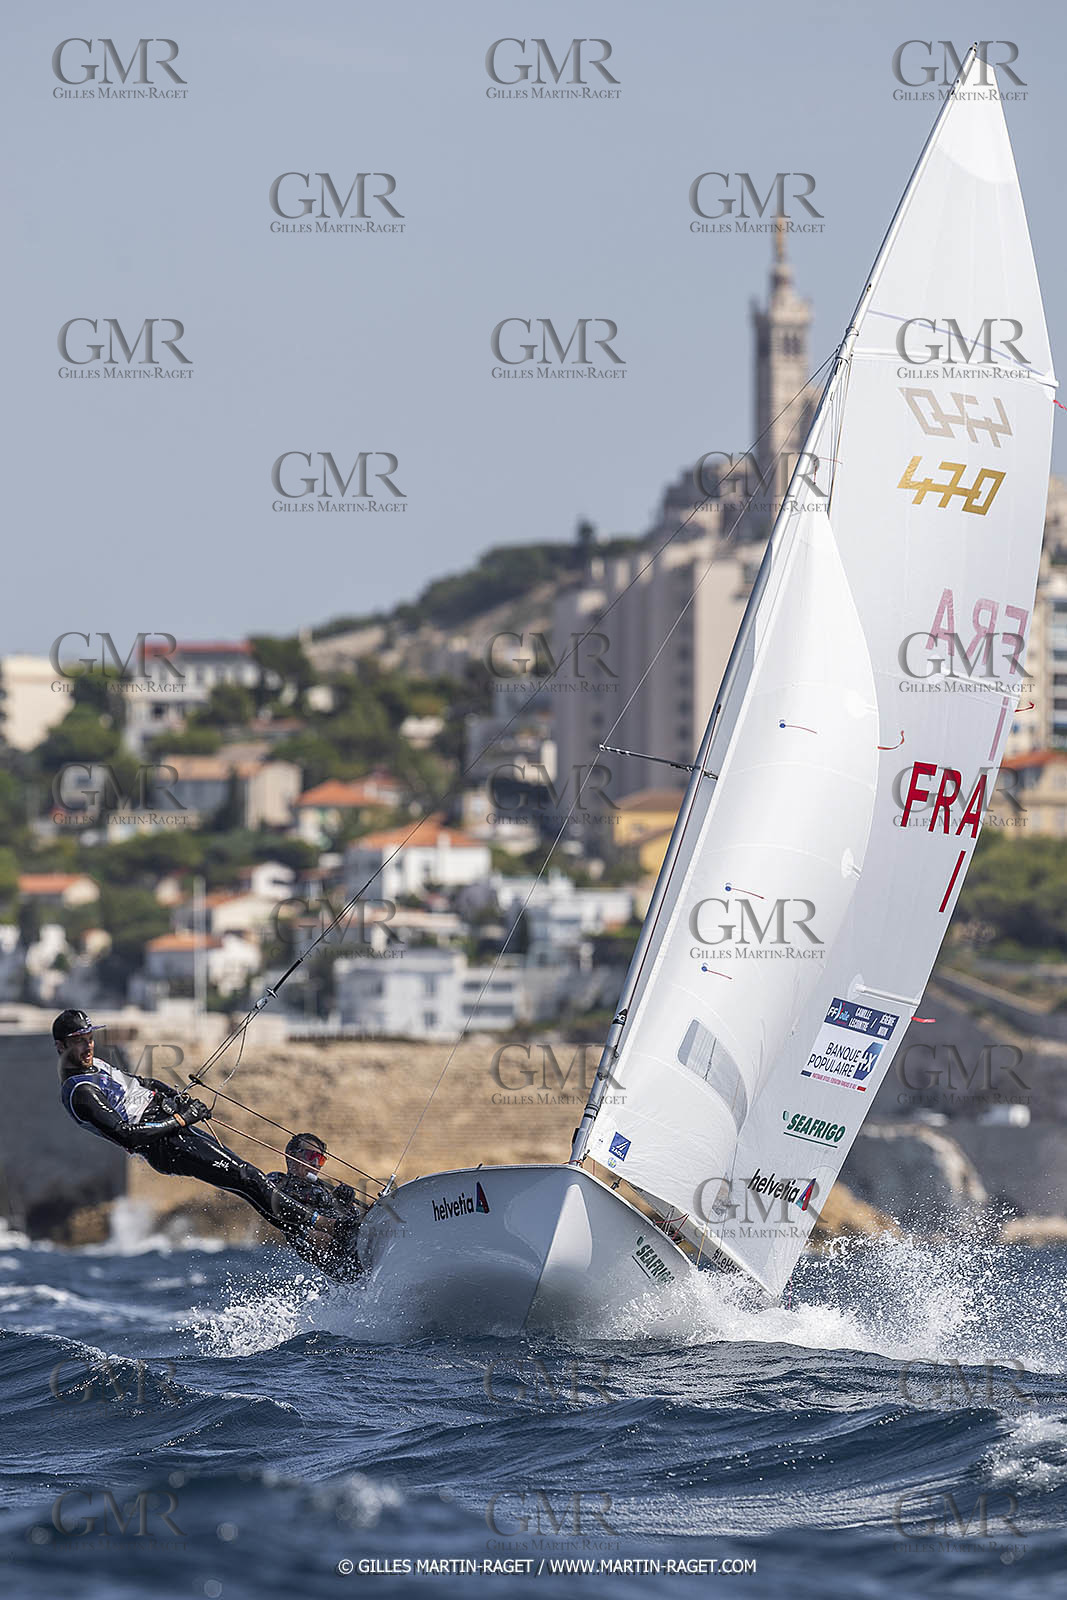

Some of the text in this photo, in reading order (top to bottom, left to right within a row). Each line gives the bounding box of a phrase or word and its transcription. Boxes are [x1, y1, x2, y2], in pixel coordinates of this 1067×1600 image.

[897, 456, 1006, 516] 470
[900, 761, 988, 838] FRA
[807, 1053, 855, 1077] POPULAIRE
[825, 1041, 862, 1063] BANQUE
[786, 1113, 846, 1142] SEAFRIGO
[747, 1168, 800, 1203] helvetia
[432, 1193, 475, 1221] helvetia
